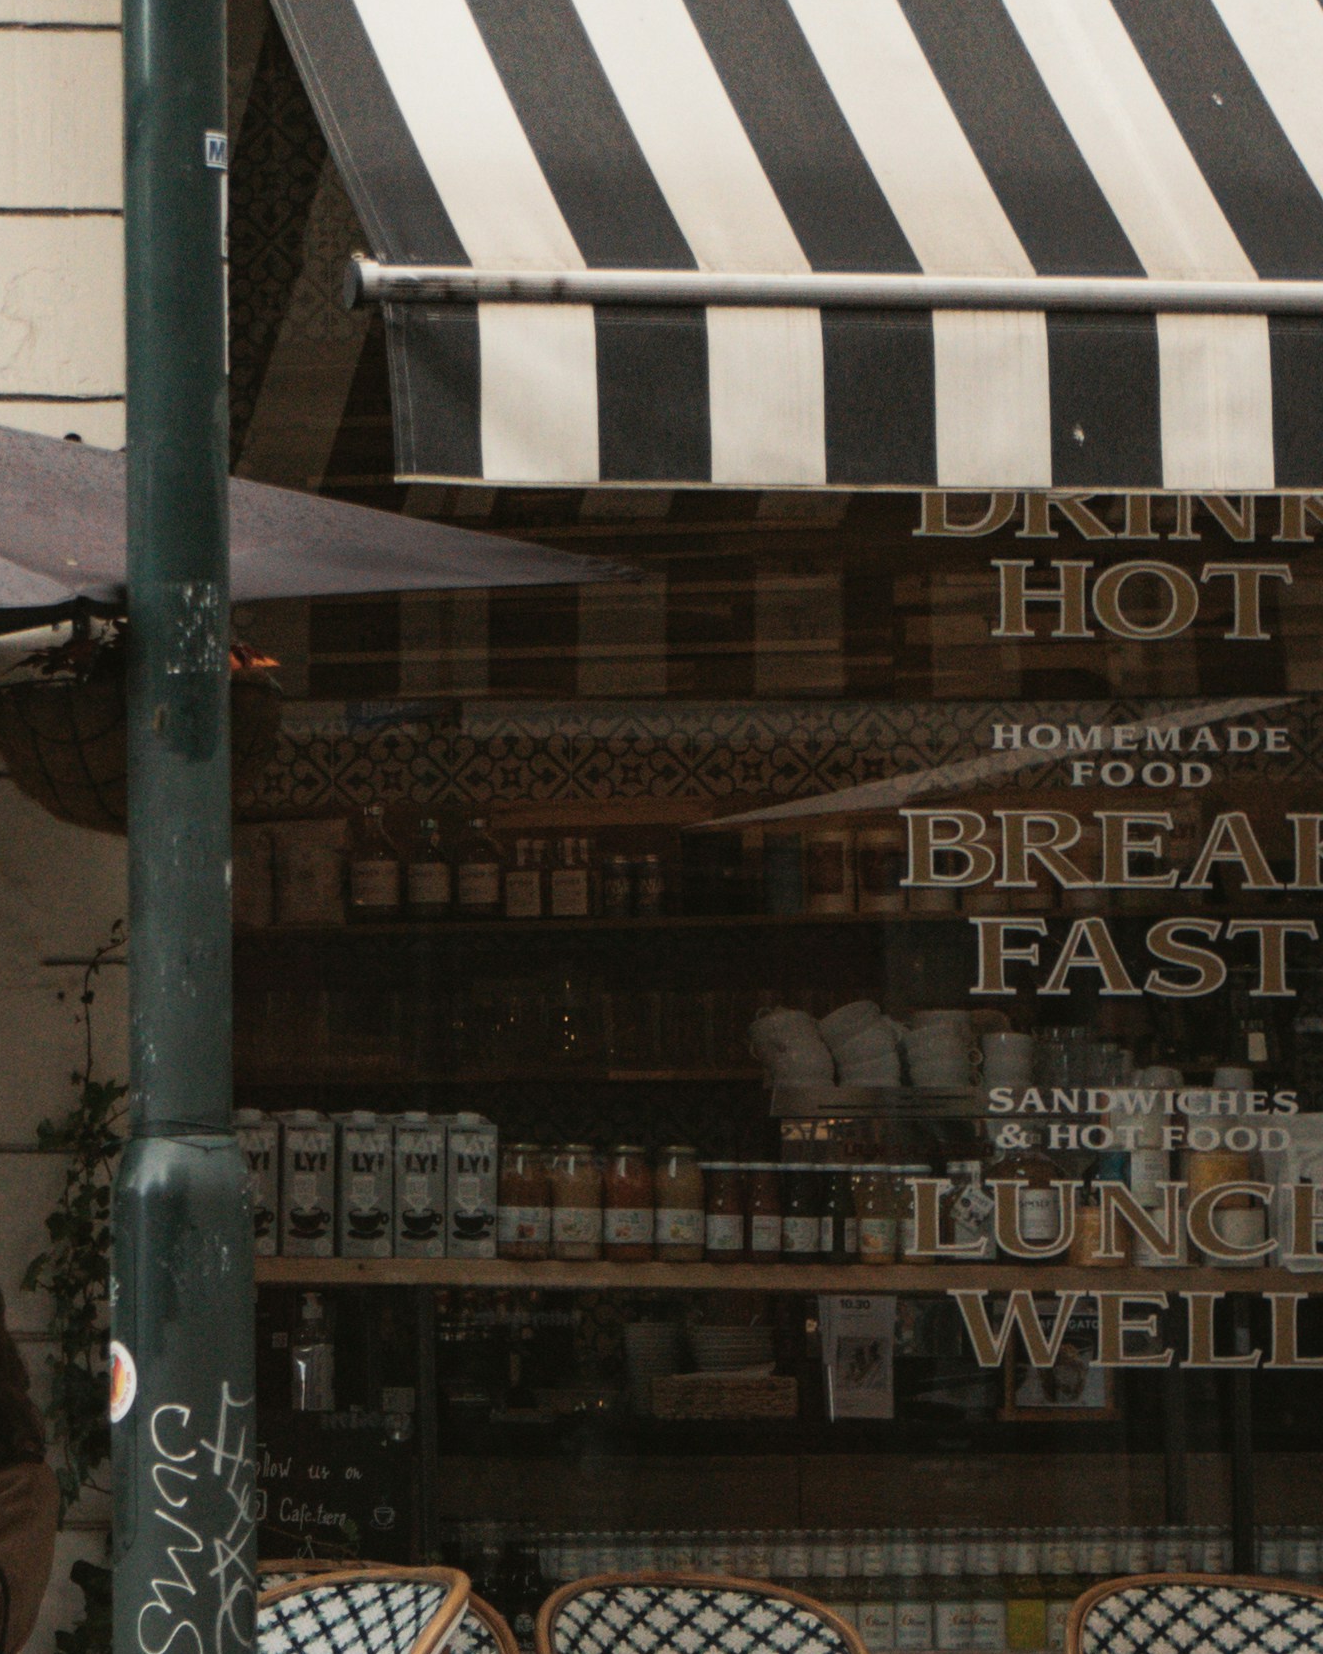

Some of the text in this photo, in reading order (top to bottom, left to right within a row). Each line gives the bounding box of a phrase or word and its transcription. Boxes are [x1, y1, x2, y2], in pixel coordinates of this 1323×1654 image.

[990, 558, 1294, 641] HOT
[991, 723, 1291, 754] HOMEMADE
[1070, 760, 1213, 789] FOOD
[968, 916, 1319, 998] FAST
[988, 1086, 1299, 1116] SANDWICHES
[996, 1123, 1027, 1150] &
[1047, 1124, 1143, 1151] HOT
[1161, 1124, 1292, 1152] FOOD
[343, 1466, 364, 1480] on
